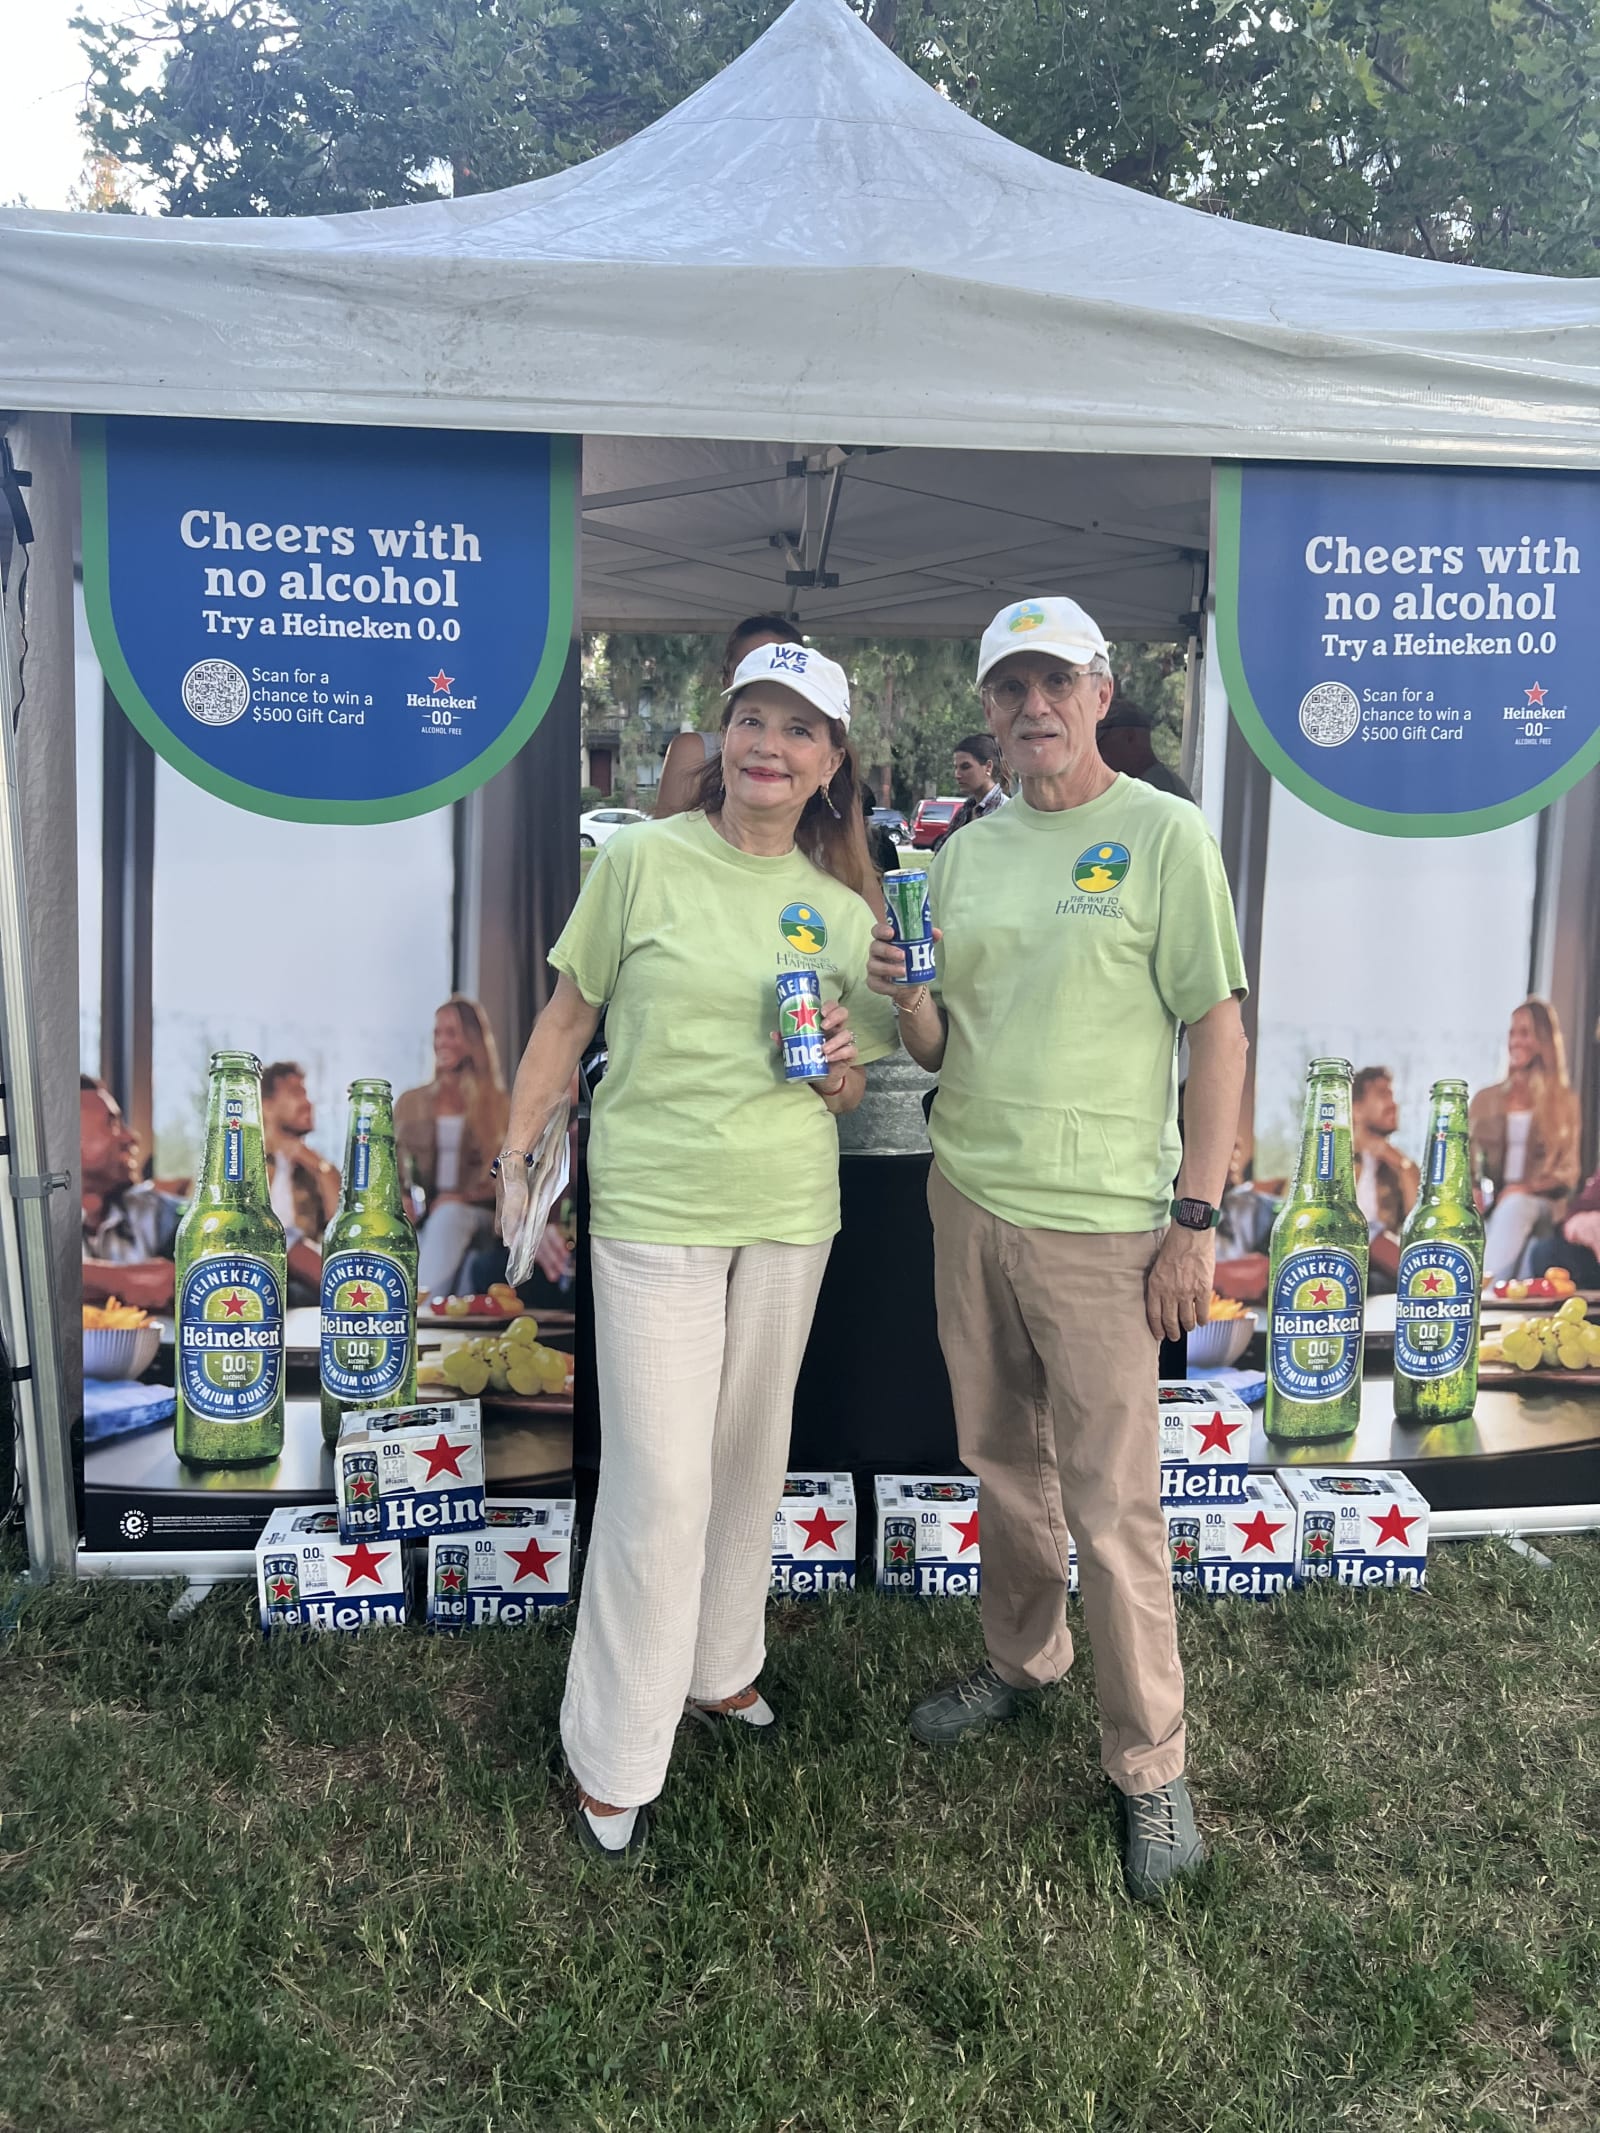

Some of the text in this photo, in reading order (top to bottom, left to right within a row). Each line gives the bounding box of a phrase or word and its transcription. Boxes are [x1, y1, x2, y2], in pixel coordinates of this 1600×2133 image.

[180, 510, 482, 562] Cheers with
[1305, 536, 1581, 574] Cheers with
[204, 564, 459, 606] no alcohol
[1324, 583, 1557, 620] no alcohol
[202, 610, 461, 641] Try a Heineken 0.0
[776, 646, 808, 663] WE
[1322, 631, 1557, 661] Try a Heineken 0.0
[252, 667, 329, 684] Scan for a
[770, 658, 807, 673] IAS
[252, 687, 373, 706] chance to win a
[406, 693, 477, 710] Heineken
[1362, 687, 1434, 702] Scan for a
[252, 705, 365, 725] $500 Gift Card
[1362, 707, 1472, 721] chance to win a
[1503, 706, 1566, 720] Heineken
[421, 726, 462, 736] ALCOHOL FREE
[1362, 725, 1463, 742] $500 Gift Card
[1055, 900, 1124, 919] HAPPINESS
[1070, 895, 1119, 905] THE WAY TO
[228, 1132, 239, 1176] Heineken
[1281, 1262, 1358, 1296] HEINEKEN 0.0
[1401, 1254, 1469, 1284] HEINEKEN 0.0
[189, 1269, 276, 1306] HEINEKEN 0.0
[324, 1264, 401, 1298] HEINEKEN 0.0
[1396, 1301, 1472, 1318] Heineken
[321, 1315, 406, 1335] Heineken
[1274, 1313, 1361, 1335] Heineken
[183, 1325, 280, 1348] Heineken
[1397, 1337, 1427, 1365] PREMIUM
[1430, 1337, 1465, 1365] QUALITY
[323, 1354, 358, 1387] PREMIUM
[361, 1354, 400, 1386] QUALITY
[1278, 1355, 1317, 1387] PREMIUM
[1320, 1352, 1354, 1386] QUALITY
[189, 1371, 234, 1406] PREMIUM
[238, 1370, 275, 1406] QUALITY
